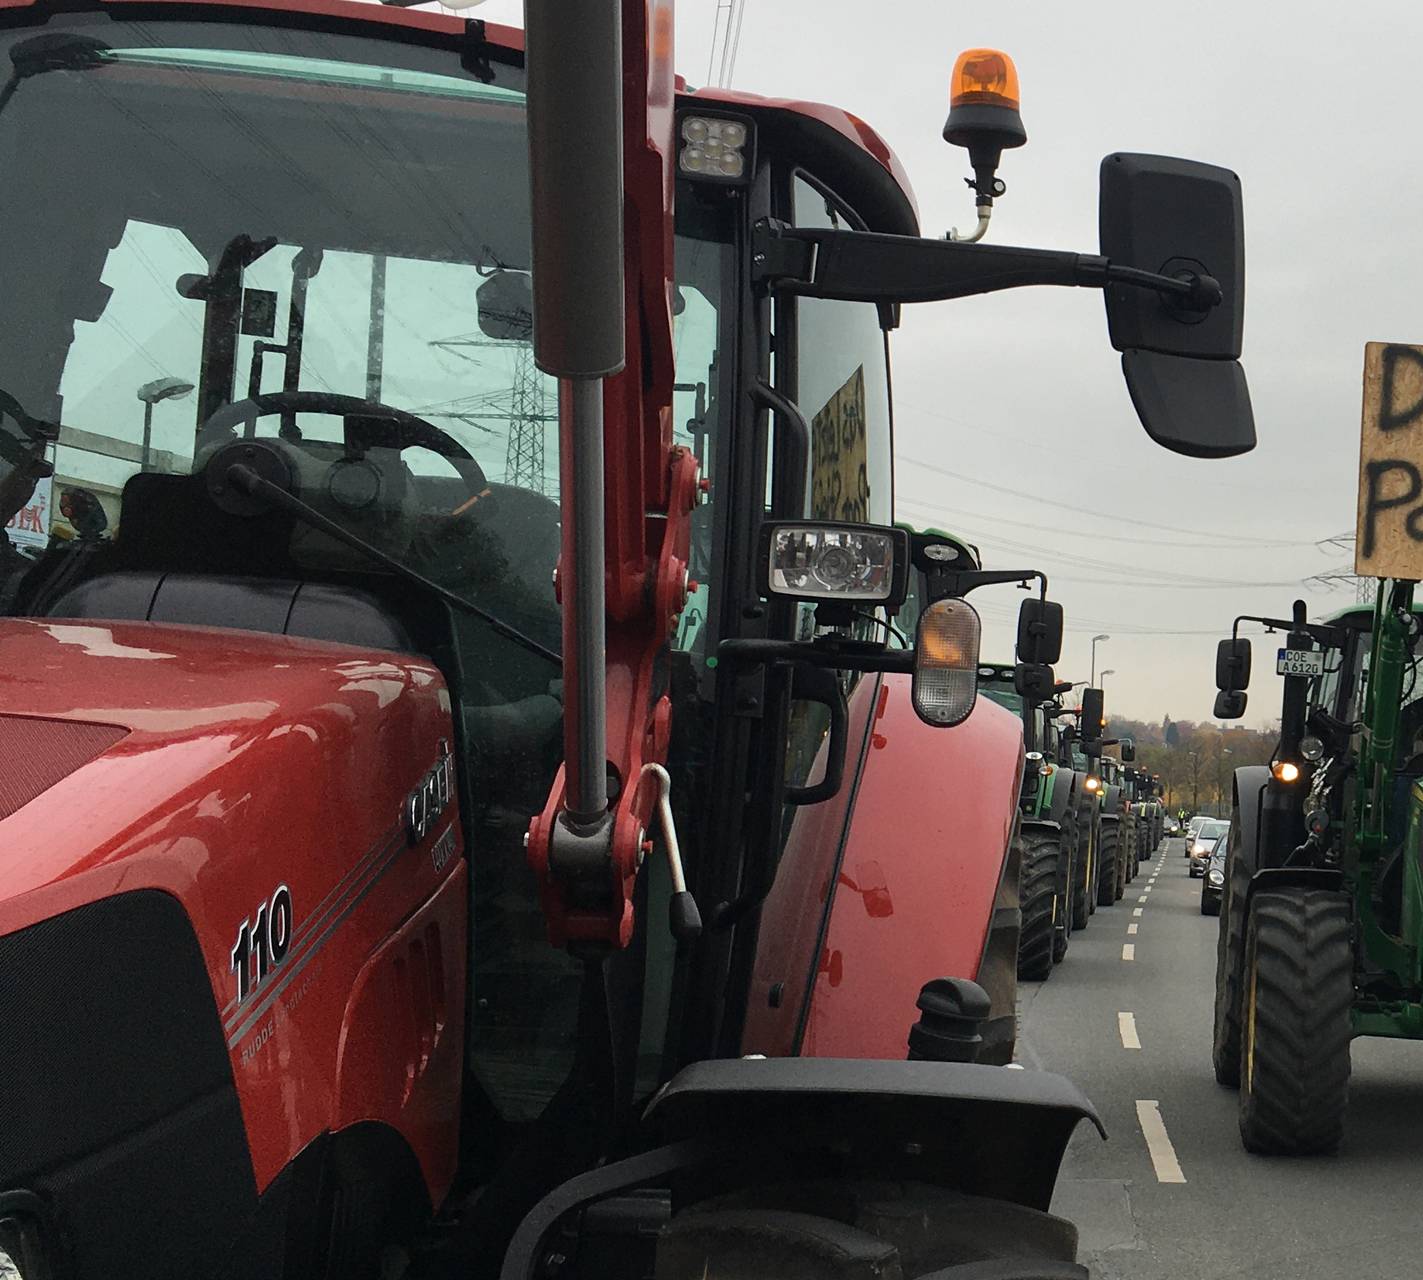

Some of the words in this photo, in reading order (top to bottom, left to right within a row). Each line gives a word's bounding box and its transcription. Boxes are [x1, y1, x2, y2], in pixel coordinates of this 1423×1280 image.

[1286, 651, 1307, 663] COE
[1291, 663, 1319, 674] 6120
[231, 884, 292, 1004] 110
